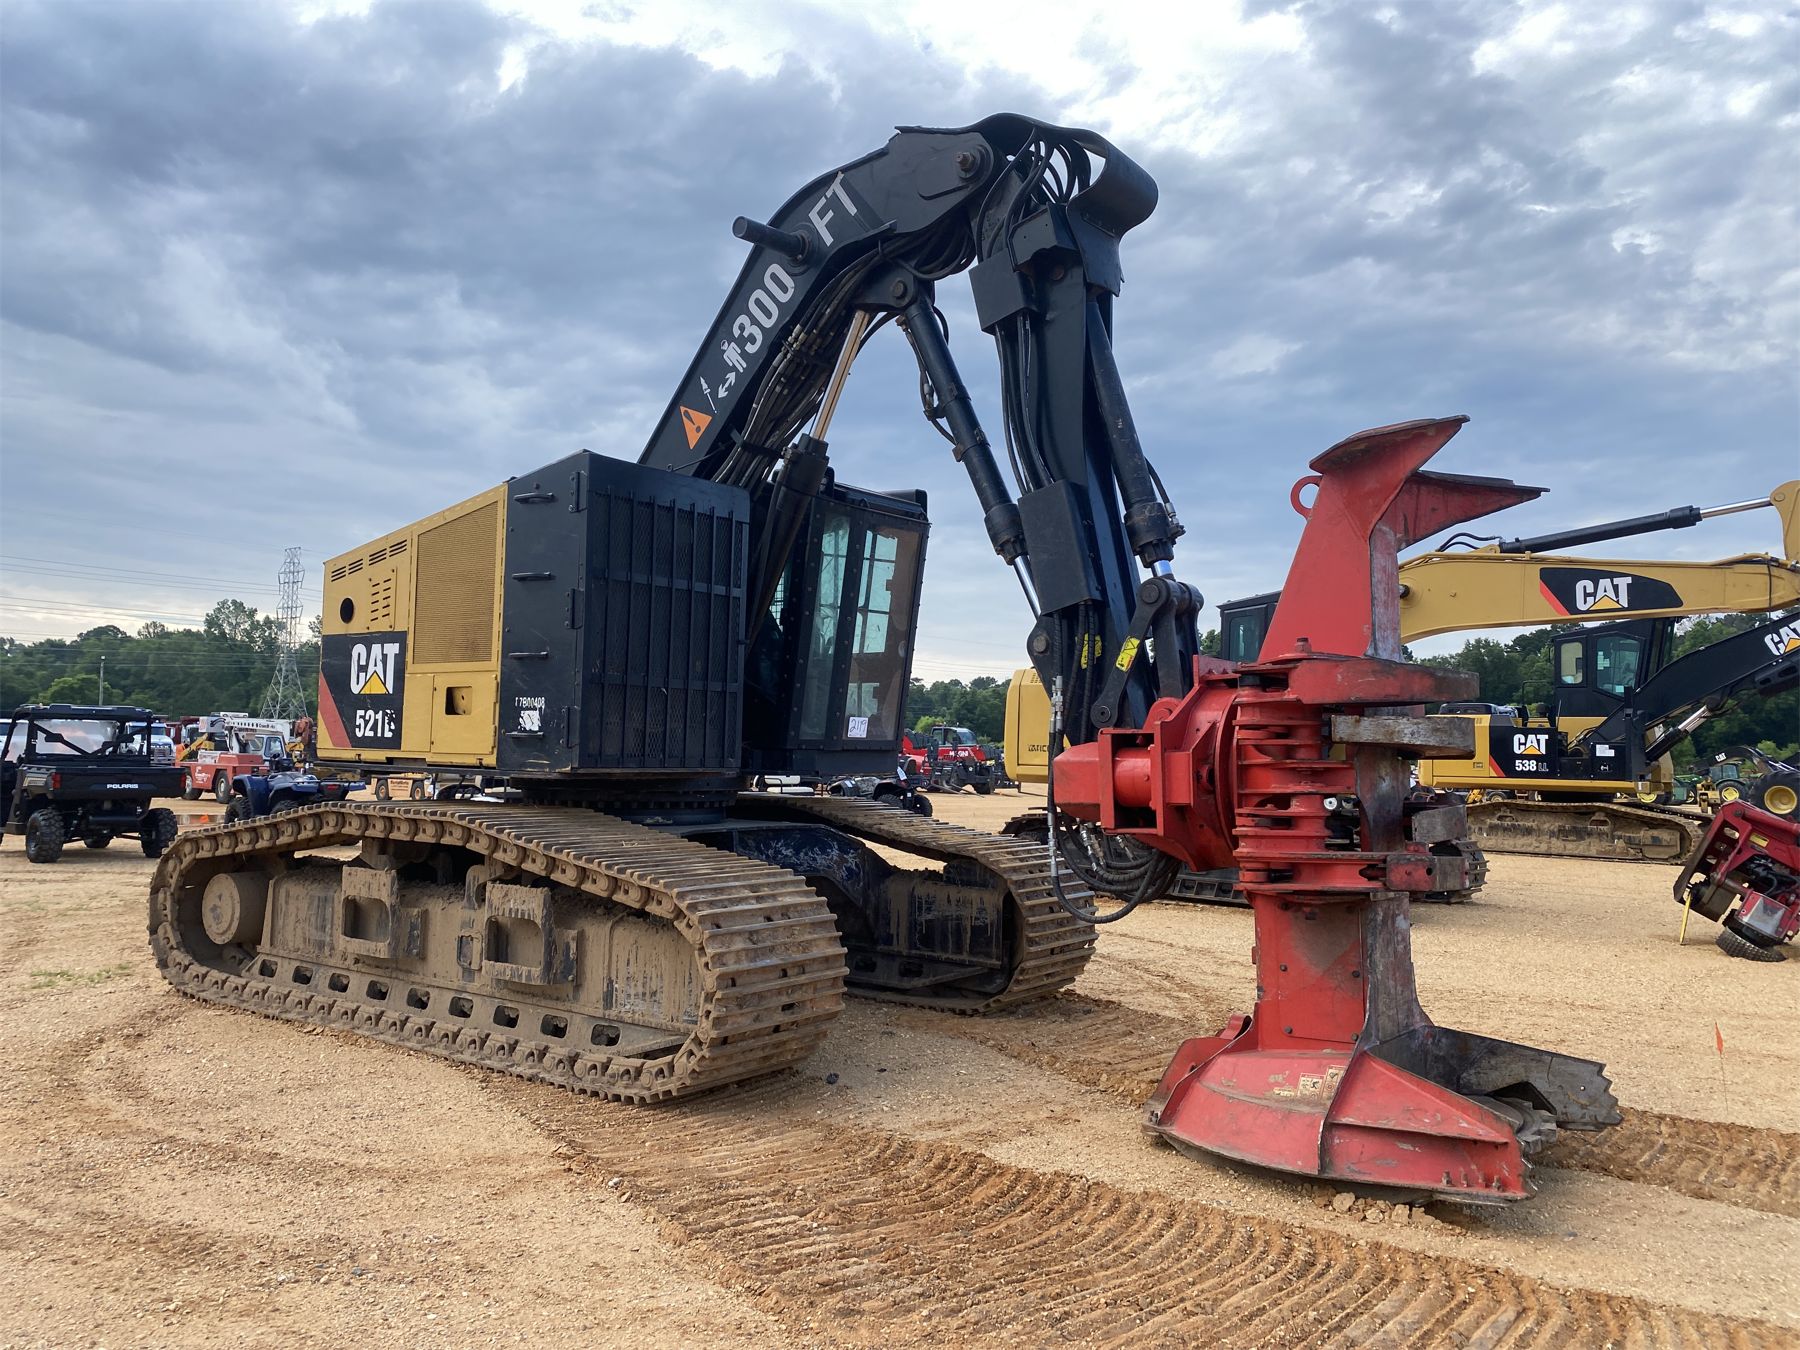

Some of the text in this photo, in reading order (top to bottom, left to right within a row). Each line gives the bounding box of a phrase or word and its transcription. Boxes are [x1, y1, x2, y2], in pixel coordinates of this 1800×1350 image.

[733, 171, 858, 354] 300 FT
[1575, 576, 1632, 611] CAT
[350, 643, 400, 695] CAT
[1513, 733, 1549, 755] CAT
[1515, 759, 1537, 771] 538
